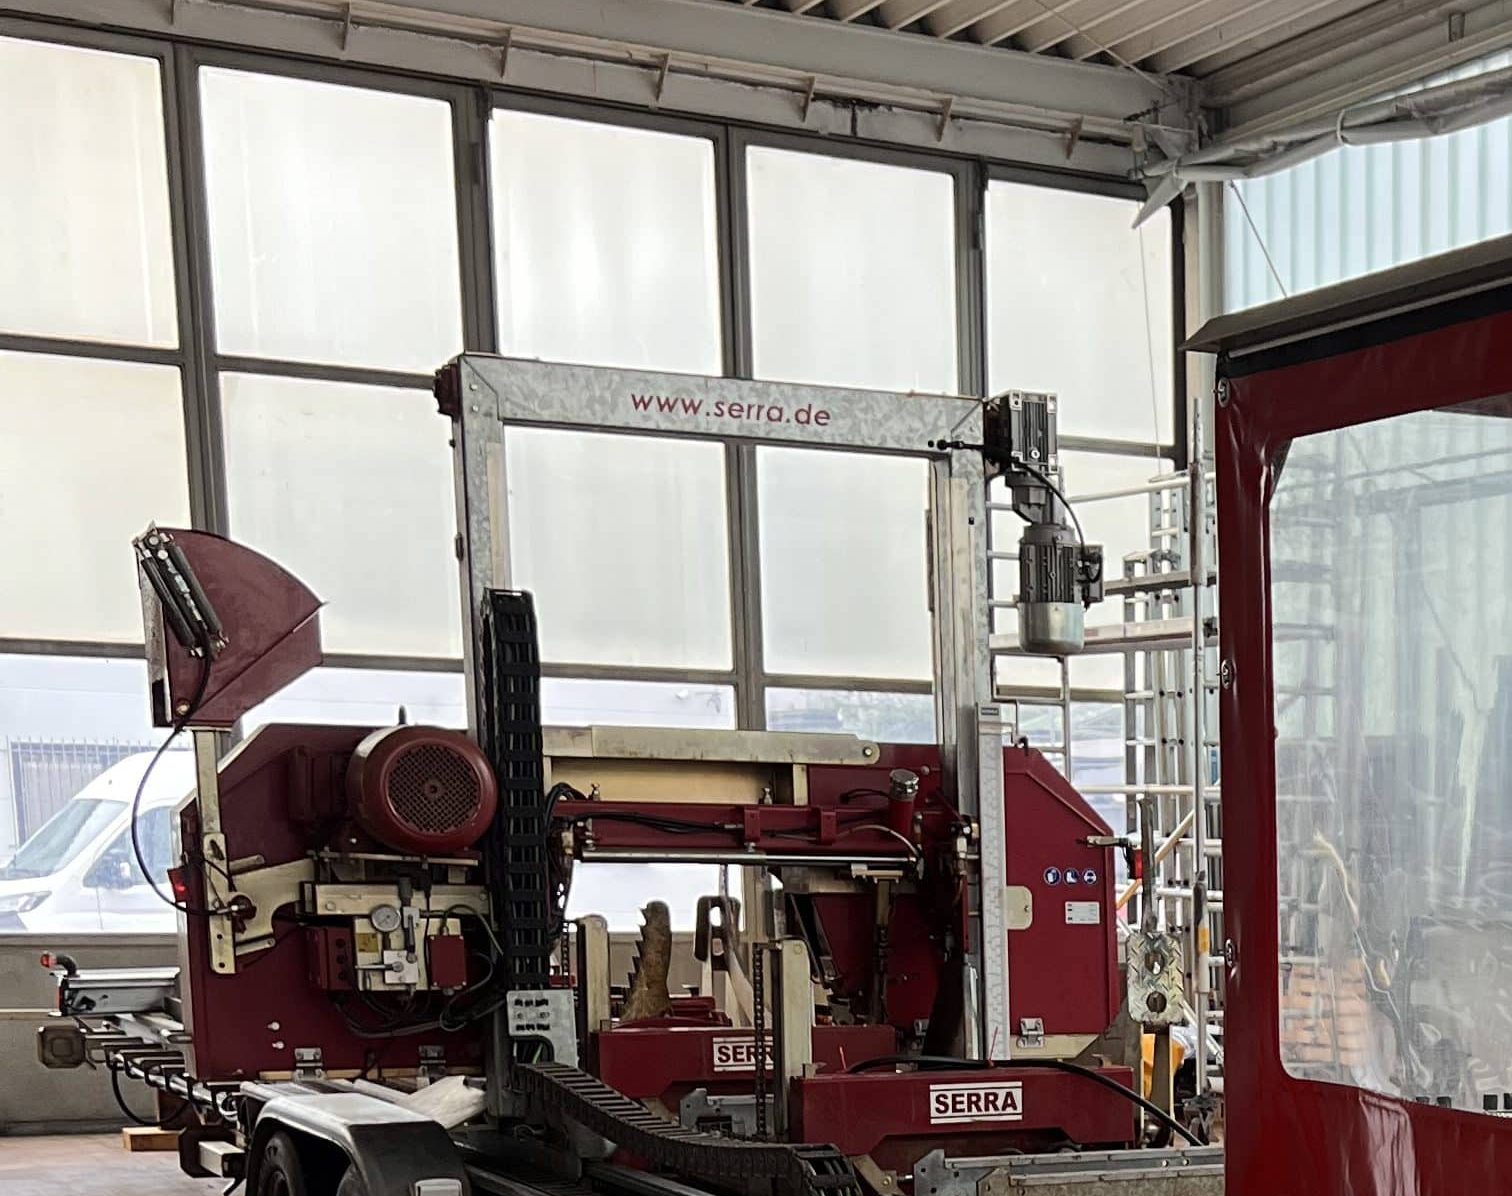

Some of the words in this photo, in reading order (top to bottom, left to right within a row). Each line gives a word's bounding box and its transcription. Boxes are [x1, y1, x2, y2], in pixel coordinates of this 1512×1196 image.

[631, 393, 831, 426] www.serra.de
[717, 1045, 774, 1063] SERR
[935, 1091, 1018, 1114] SERRA
